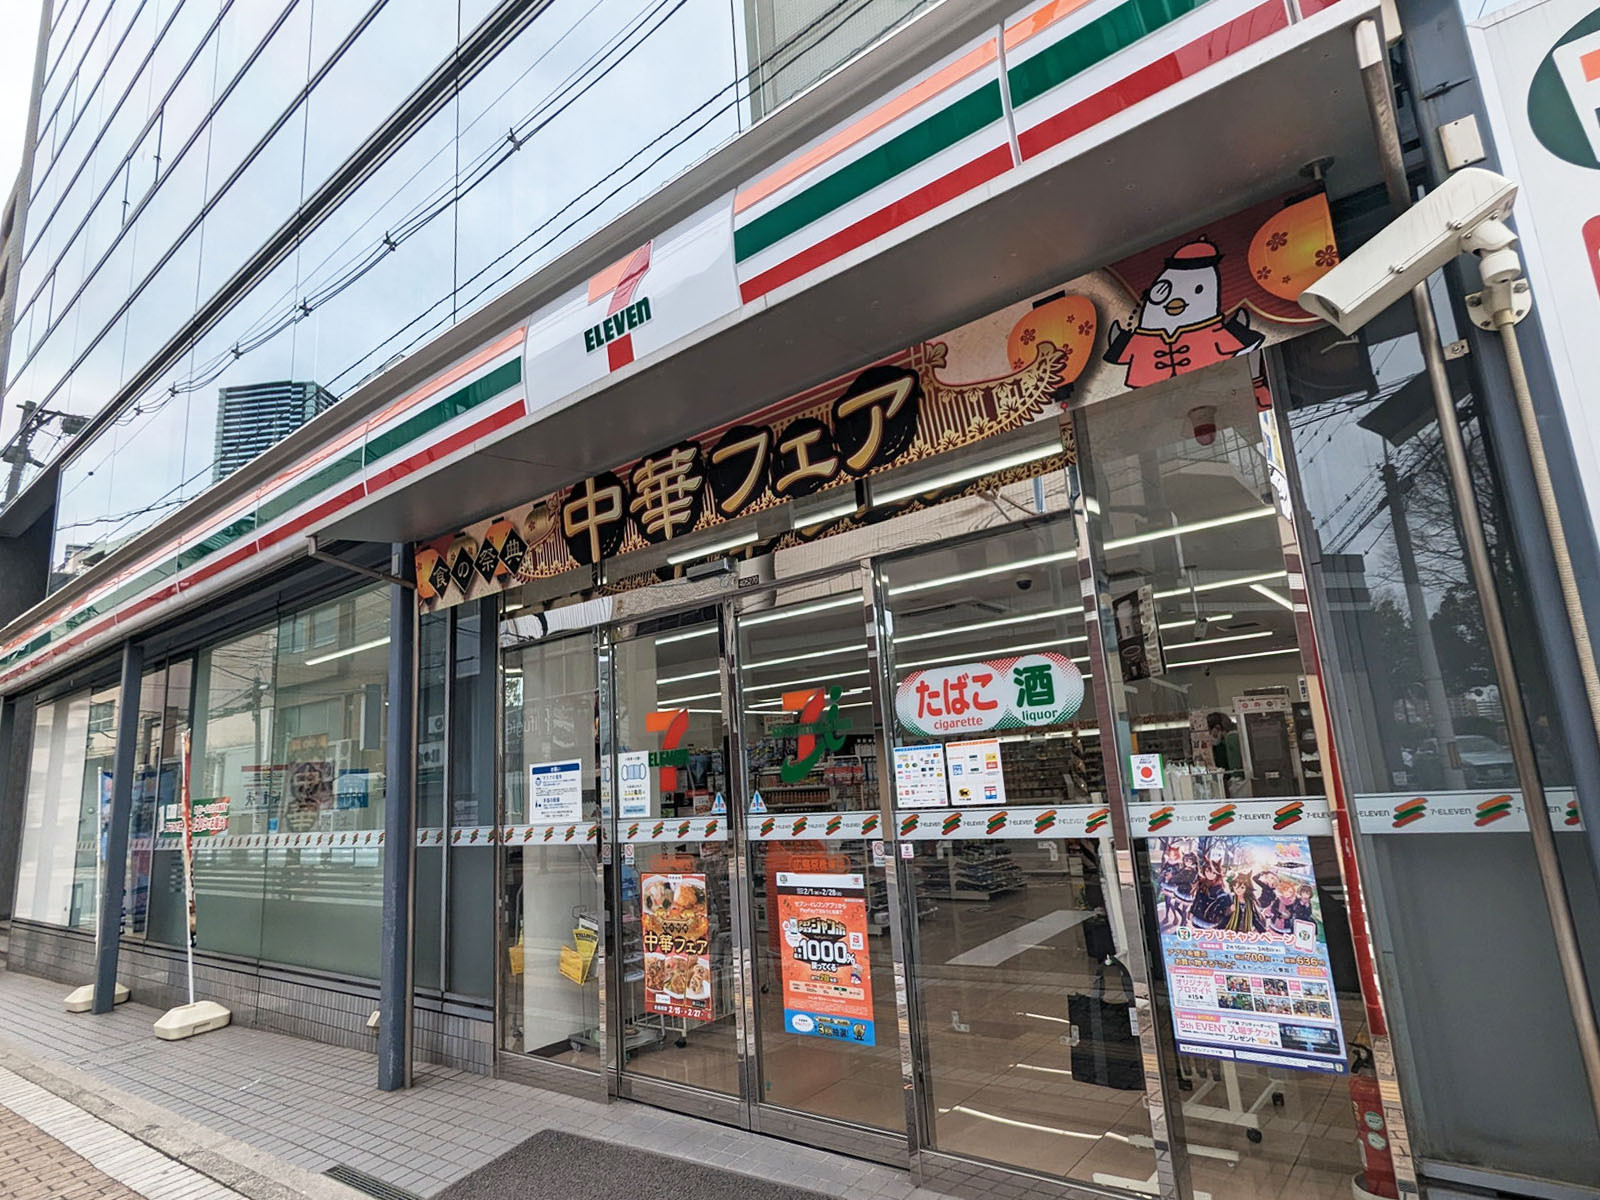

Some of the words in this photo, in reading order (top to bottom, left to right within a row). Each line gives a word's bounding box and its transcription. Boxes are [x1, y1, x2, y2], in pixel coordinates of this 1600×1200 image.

[564, 377, 911, 564] 中華フェア
[433, 539, 523, 588] 食の祭典
[915, 672, 998, 719] たばこ
[1013, 663, 1056, 708] 酒
[934, 716, 984, 731] cigarette
[1022, 707, 1059, 722] liquor
[645, 931, 708, 954] 中華フェア
[1193, 928, 1296, 945] アプリキャンペーン
[1196, 1022, 1227, 1033] EVENT
